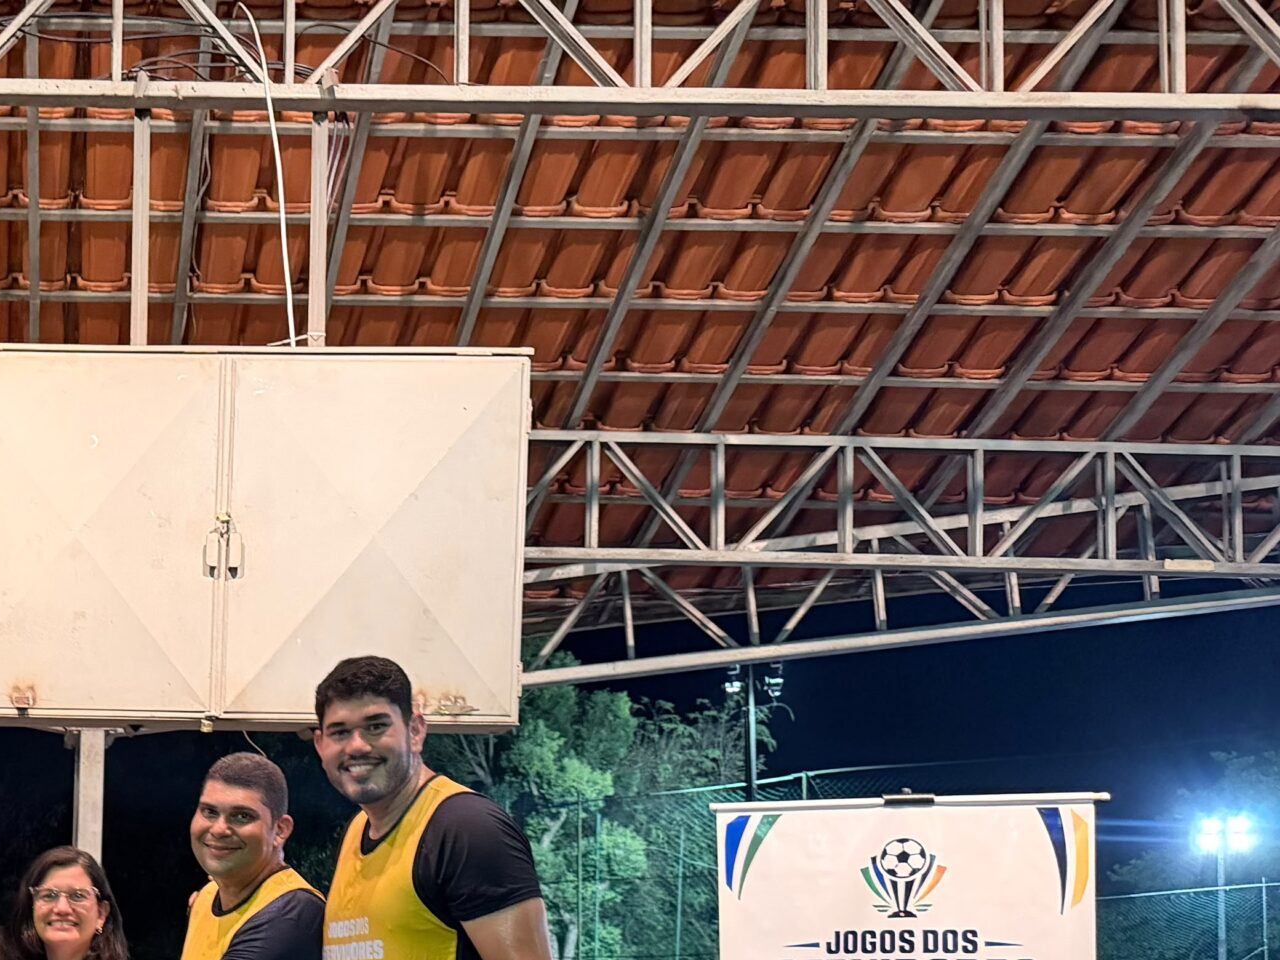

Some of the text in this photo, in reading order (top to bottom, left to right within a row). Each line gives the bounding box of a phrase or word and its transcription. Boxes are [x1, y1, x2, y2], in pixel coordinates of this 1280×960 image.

[328, 919, 356, 938] JOGOS
[826, 929, 978, 955] JOGOS DOS
